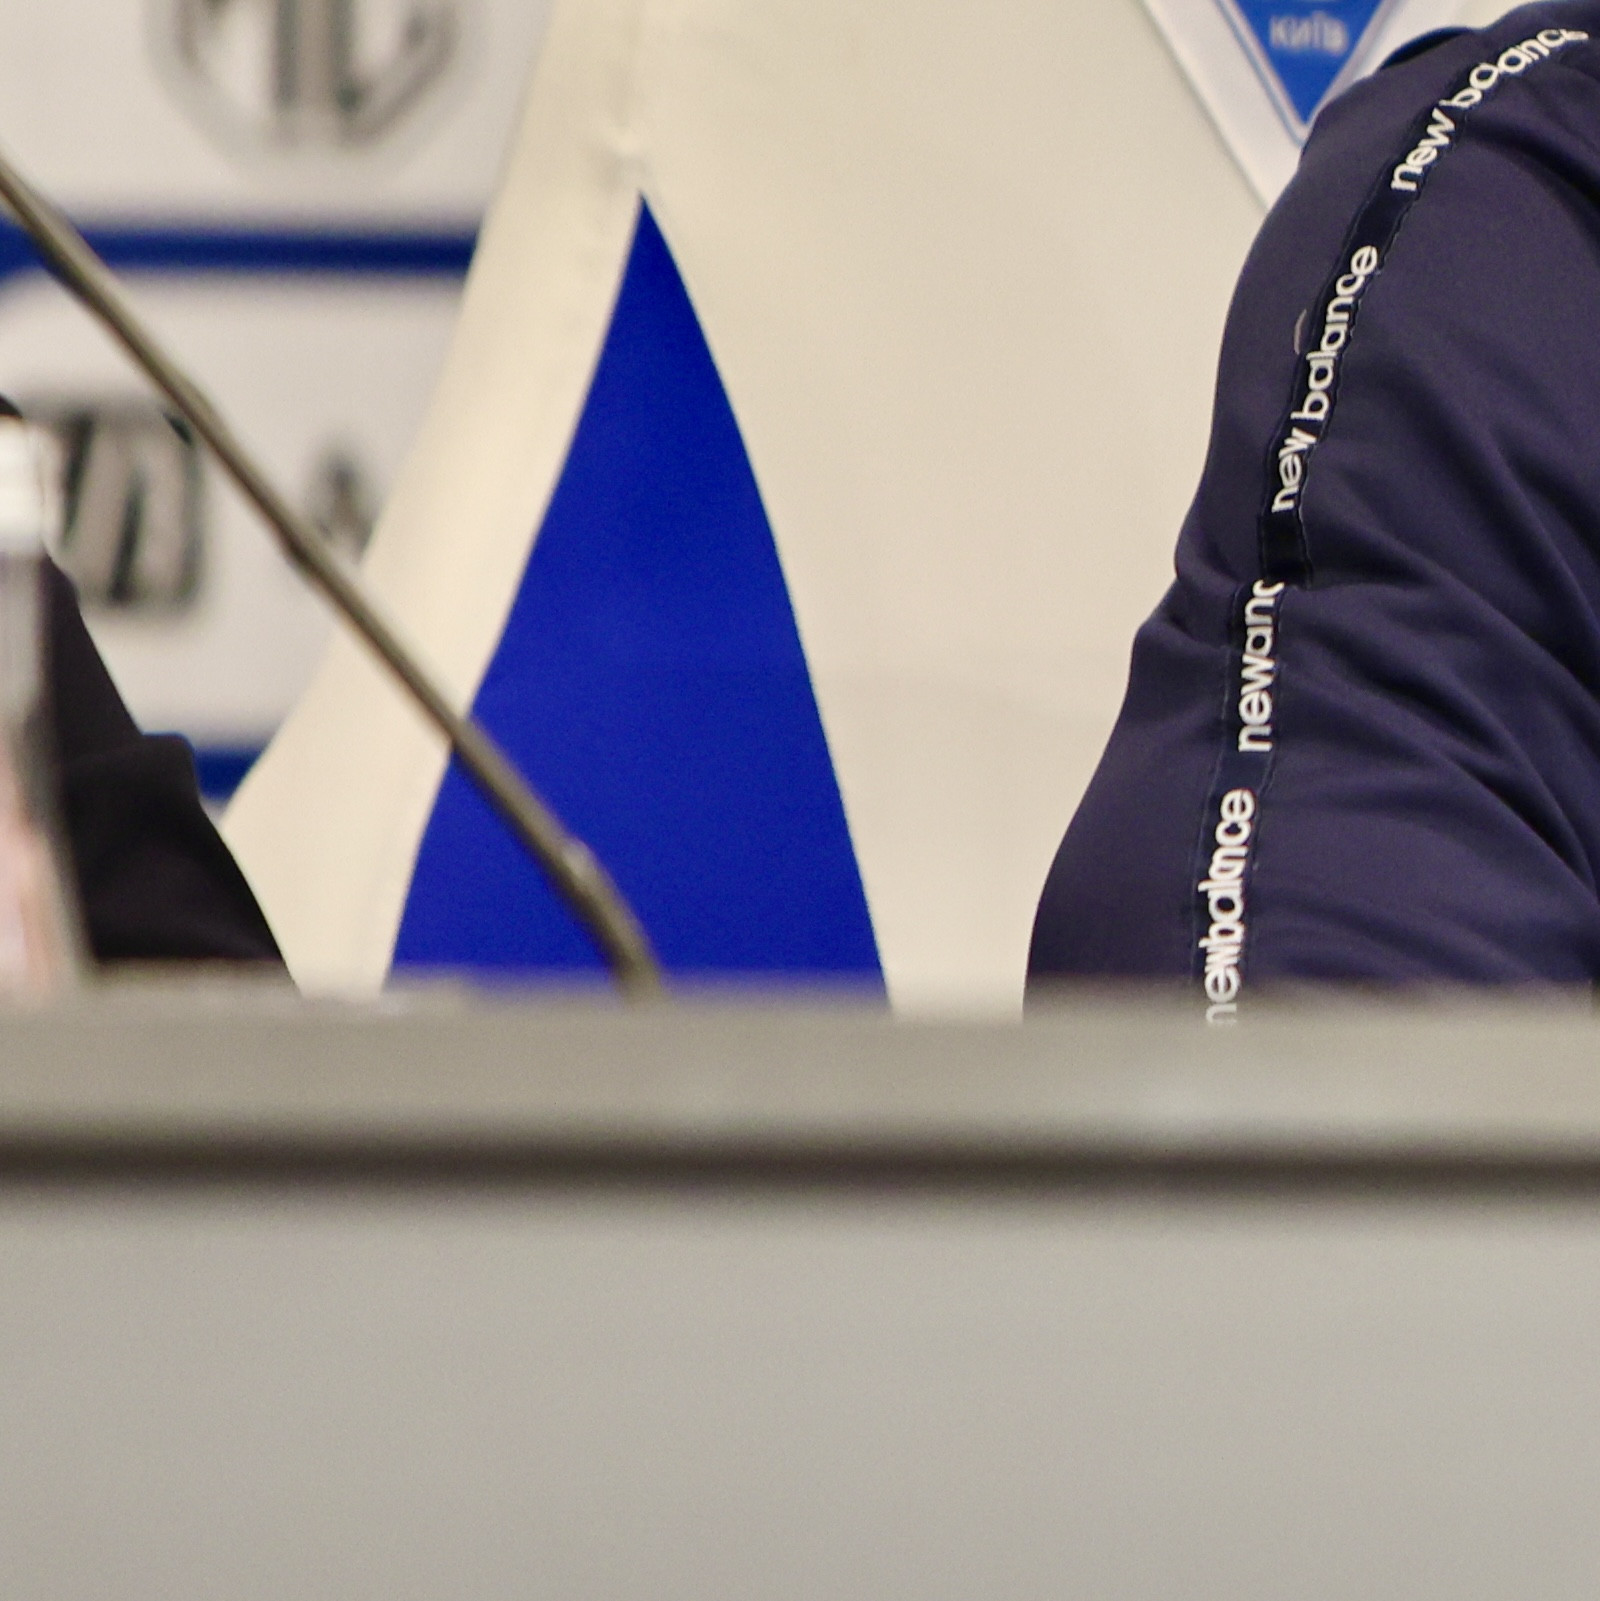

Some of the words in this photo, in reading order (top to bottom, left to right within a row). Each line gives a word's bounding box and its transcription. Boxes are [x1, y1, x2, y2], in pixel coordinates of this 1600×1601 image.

[1390, 108, 1455, 191] new
[1290, 245, 1377, 421] balance
[1271, 427, 1317, 513] new
